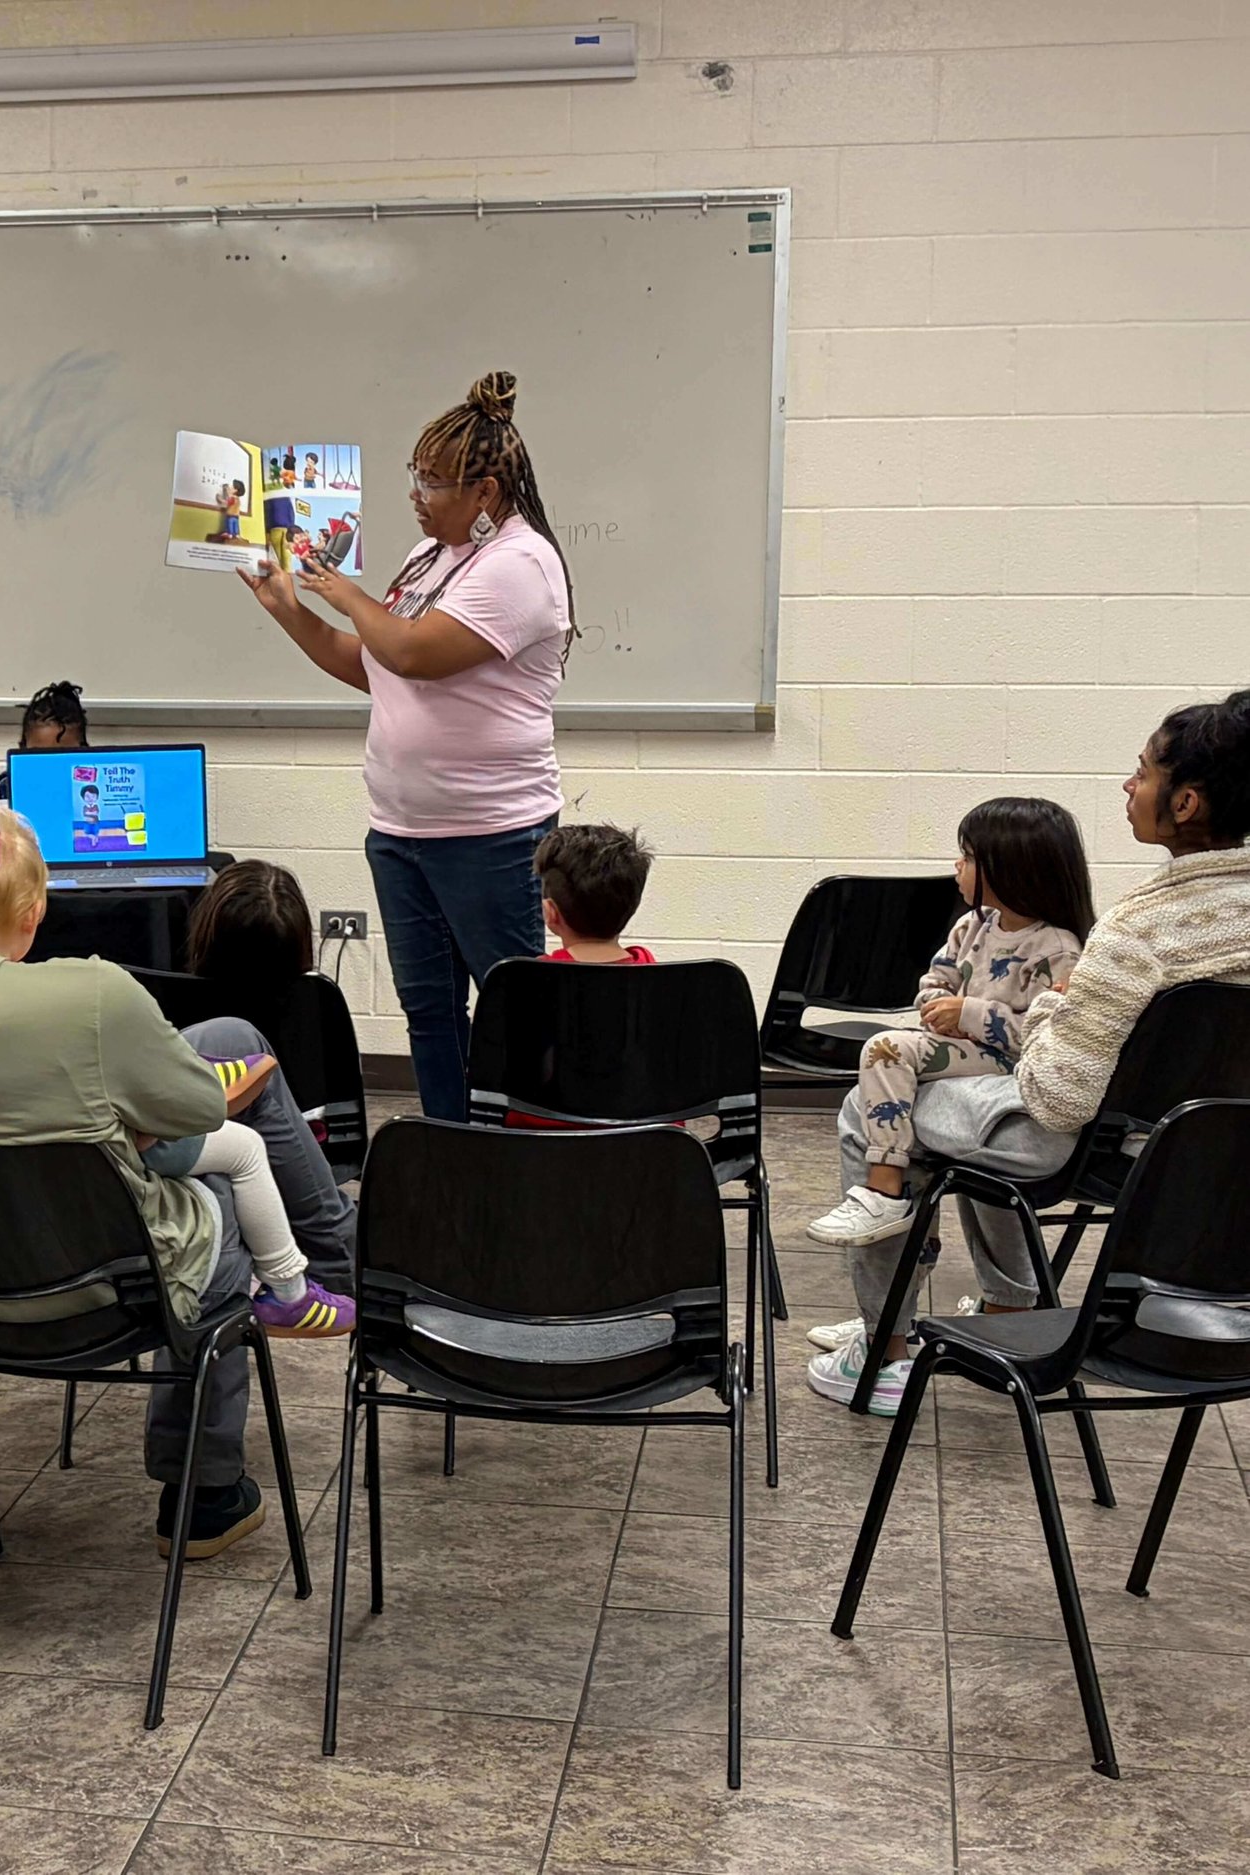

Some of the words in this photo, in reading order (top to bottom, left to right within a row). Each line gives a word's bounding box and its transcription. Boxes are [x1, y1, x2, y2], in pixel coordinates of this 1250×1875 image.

[552, 504, 625, 547] time
[108, 776, 130, 784] Truth
[105, 784, 134, 793] Timmy
